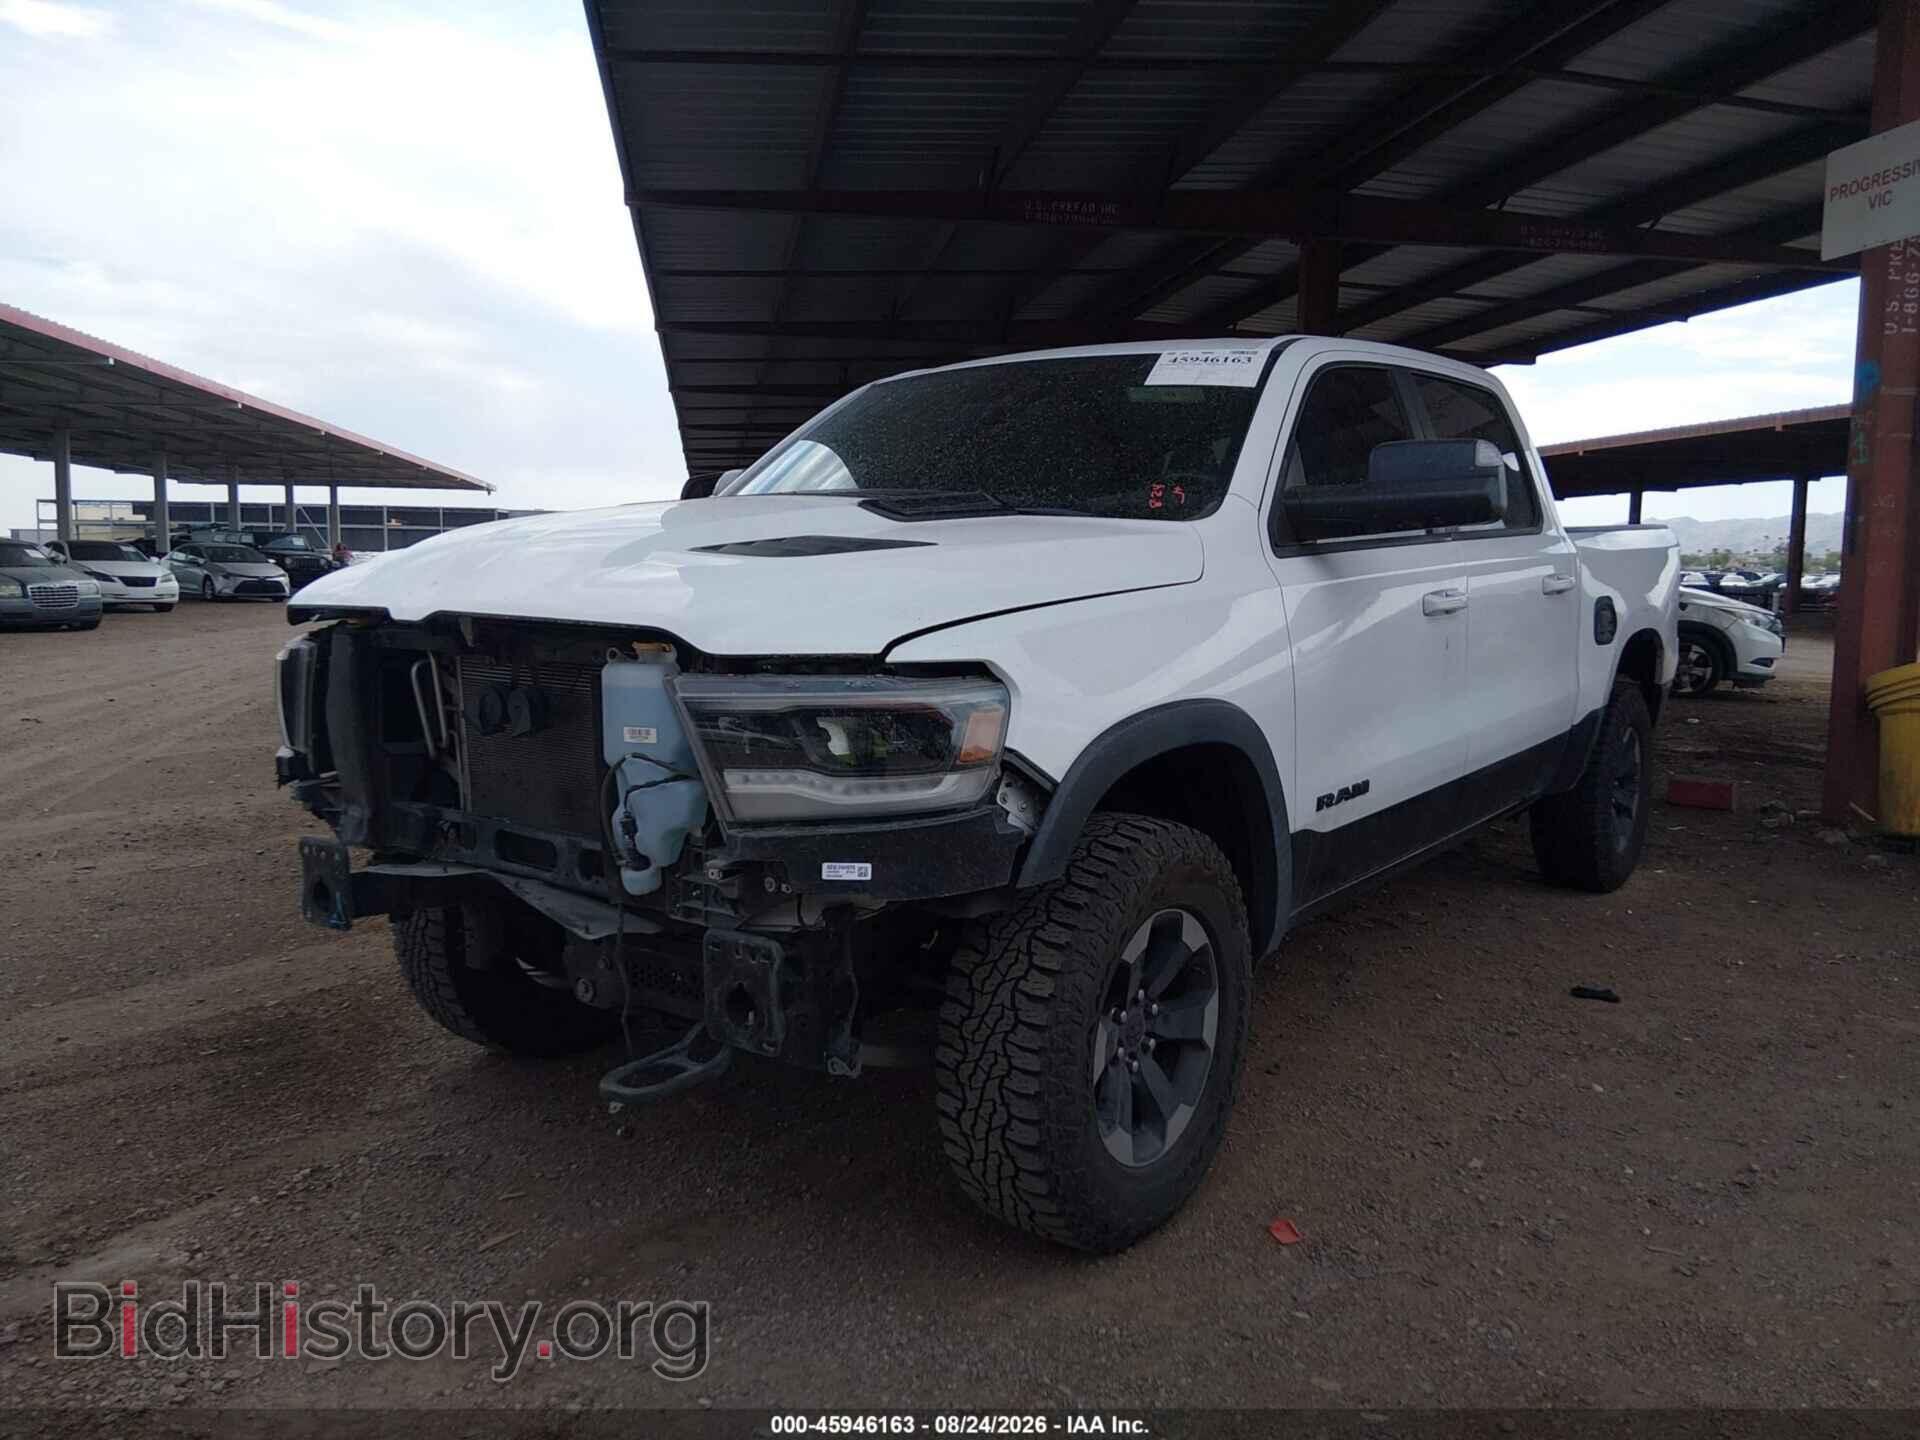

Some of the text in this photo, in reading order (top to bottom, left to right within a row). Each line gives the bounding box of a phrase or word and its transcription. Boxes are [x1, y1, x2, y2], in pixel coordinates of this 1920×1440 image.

[1868, 190, 1894, 209] VIC
[1168, 356, 1252, 365] 45946163
[1316, 779, 1370, 812] RAM
